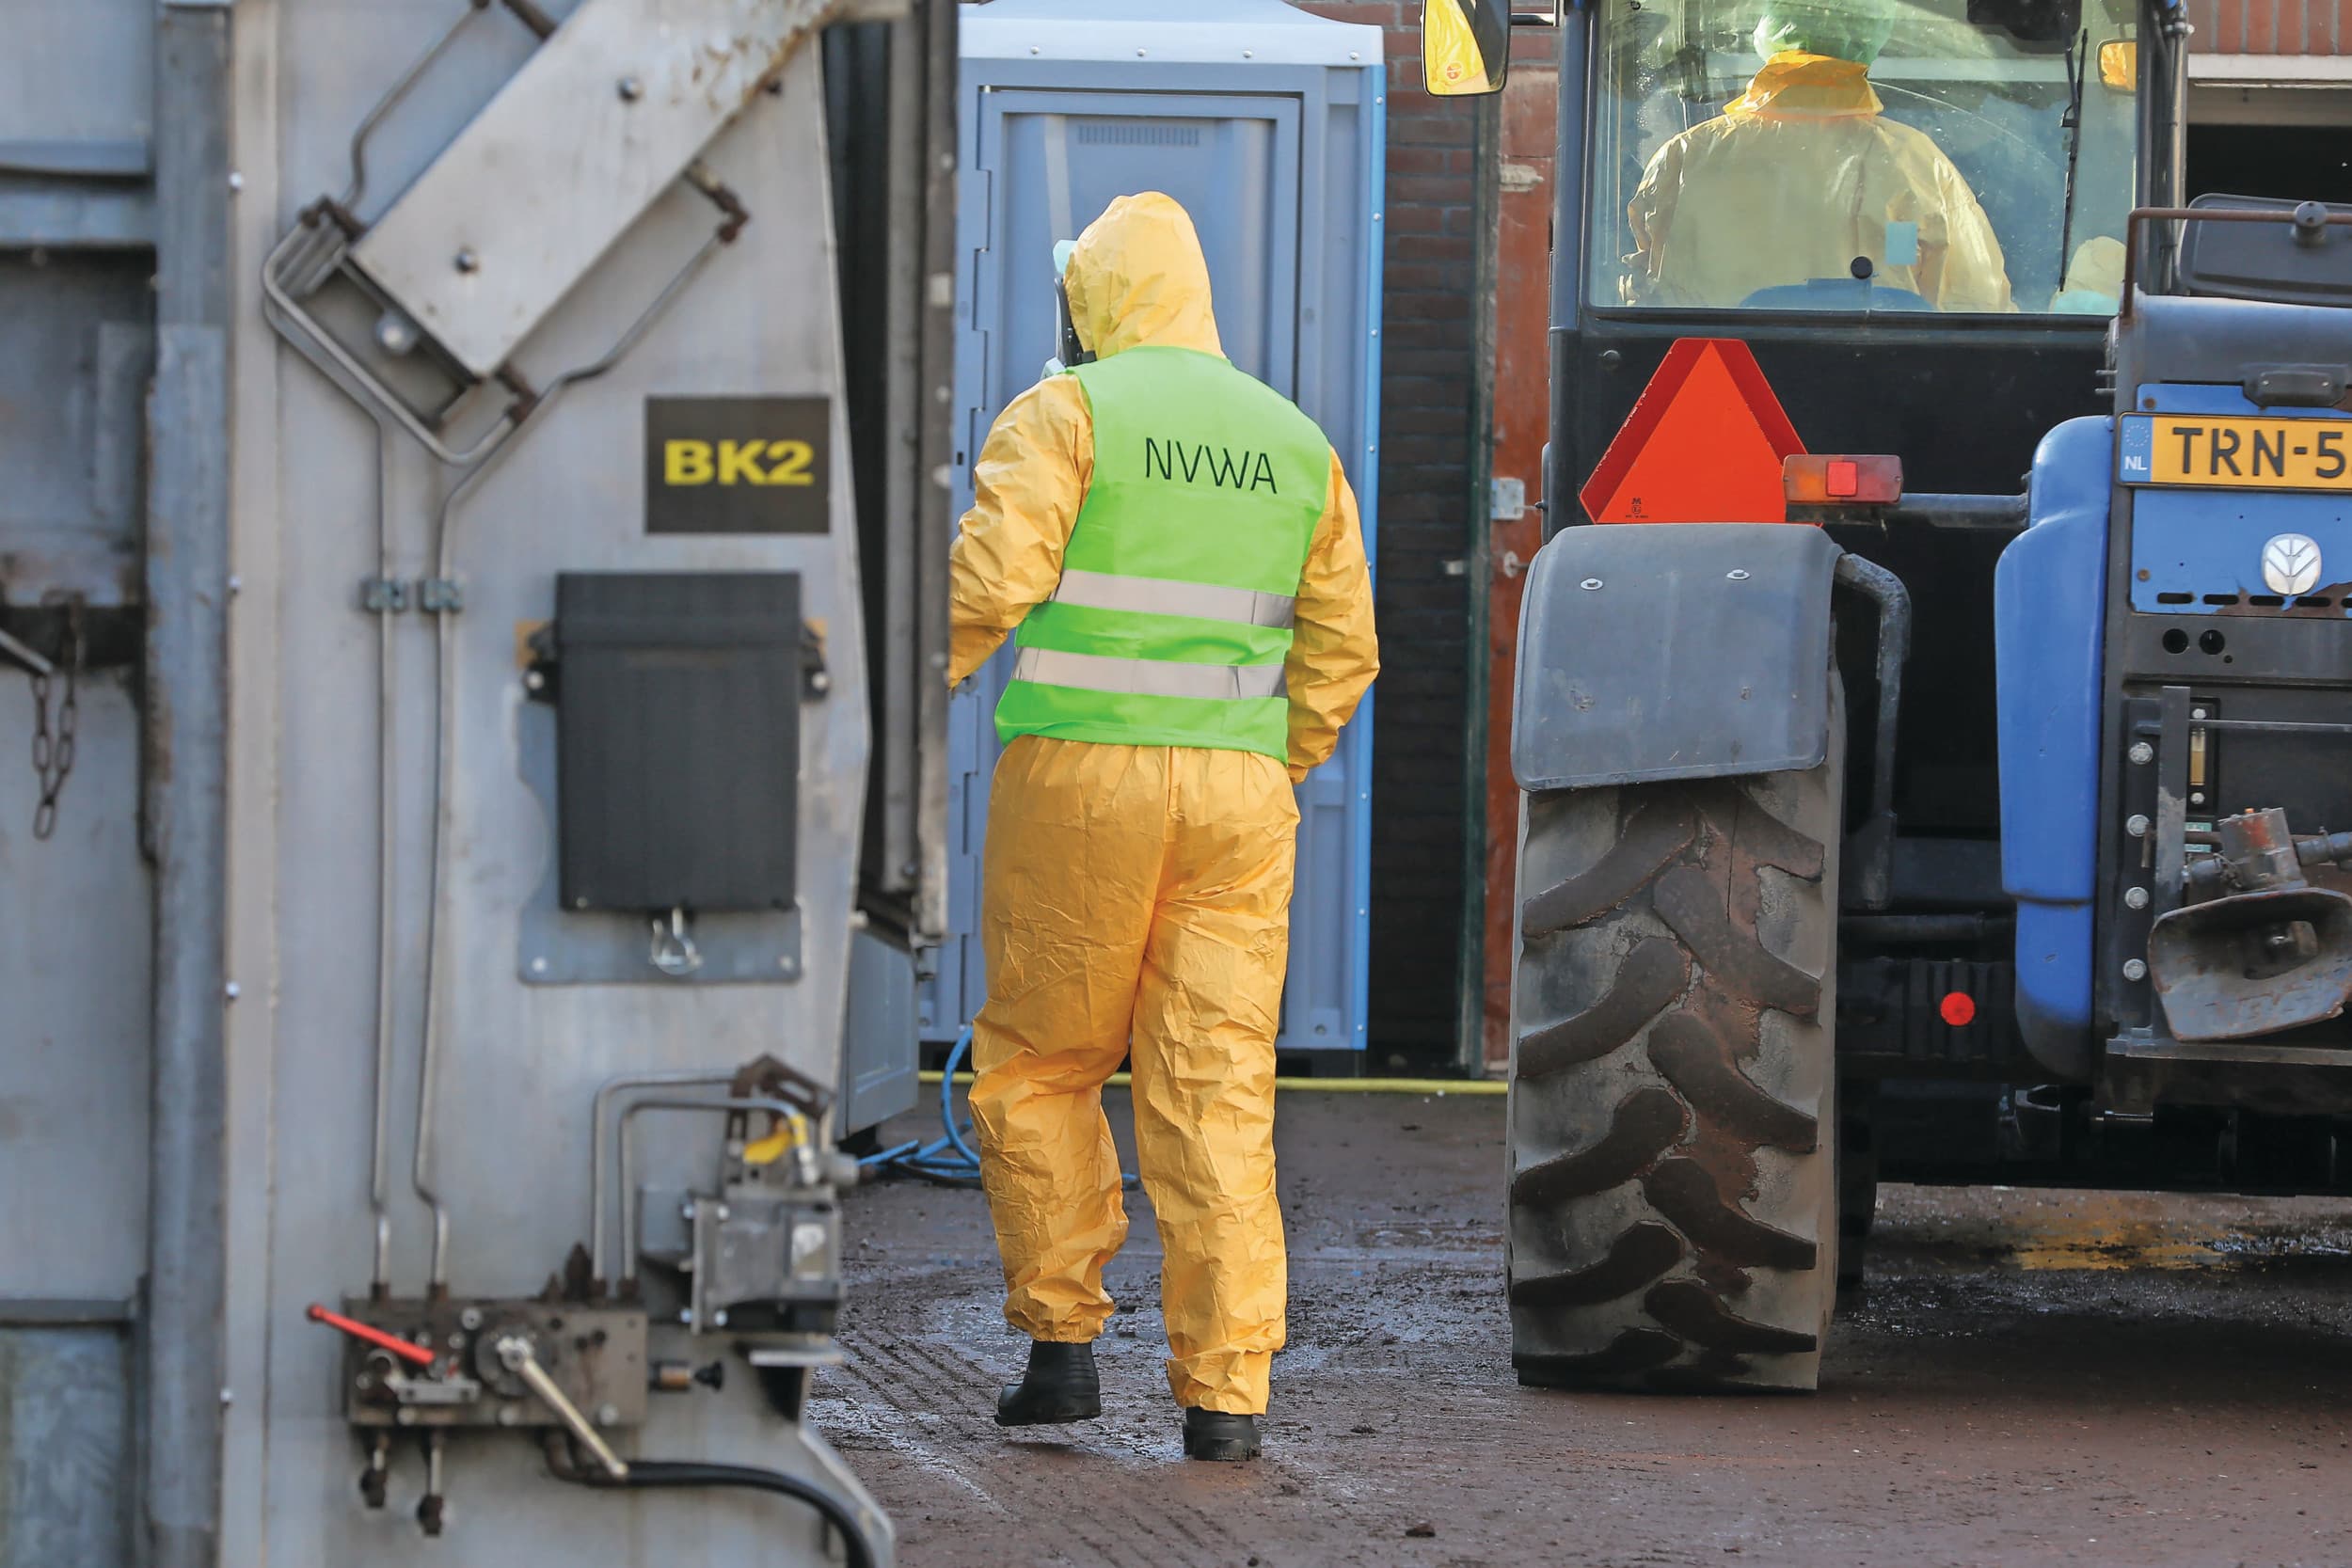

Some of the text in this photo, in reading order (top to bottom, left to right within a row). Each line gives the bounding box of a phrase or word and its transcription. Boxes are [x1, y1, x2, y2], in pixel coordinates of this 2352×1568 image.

[664, 439, 814, 485] BK2
[1146, 437, 1277, 494] NVWA
[2124, 456, 2147, 470] NL
